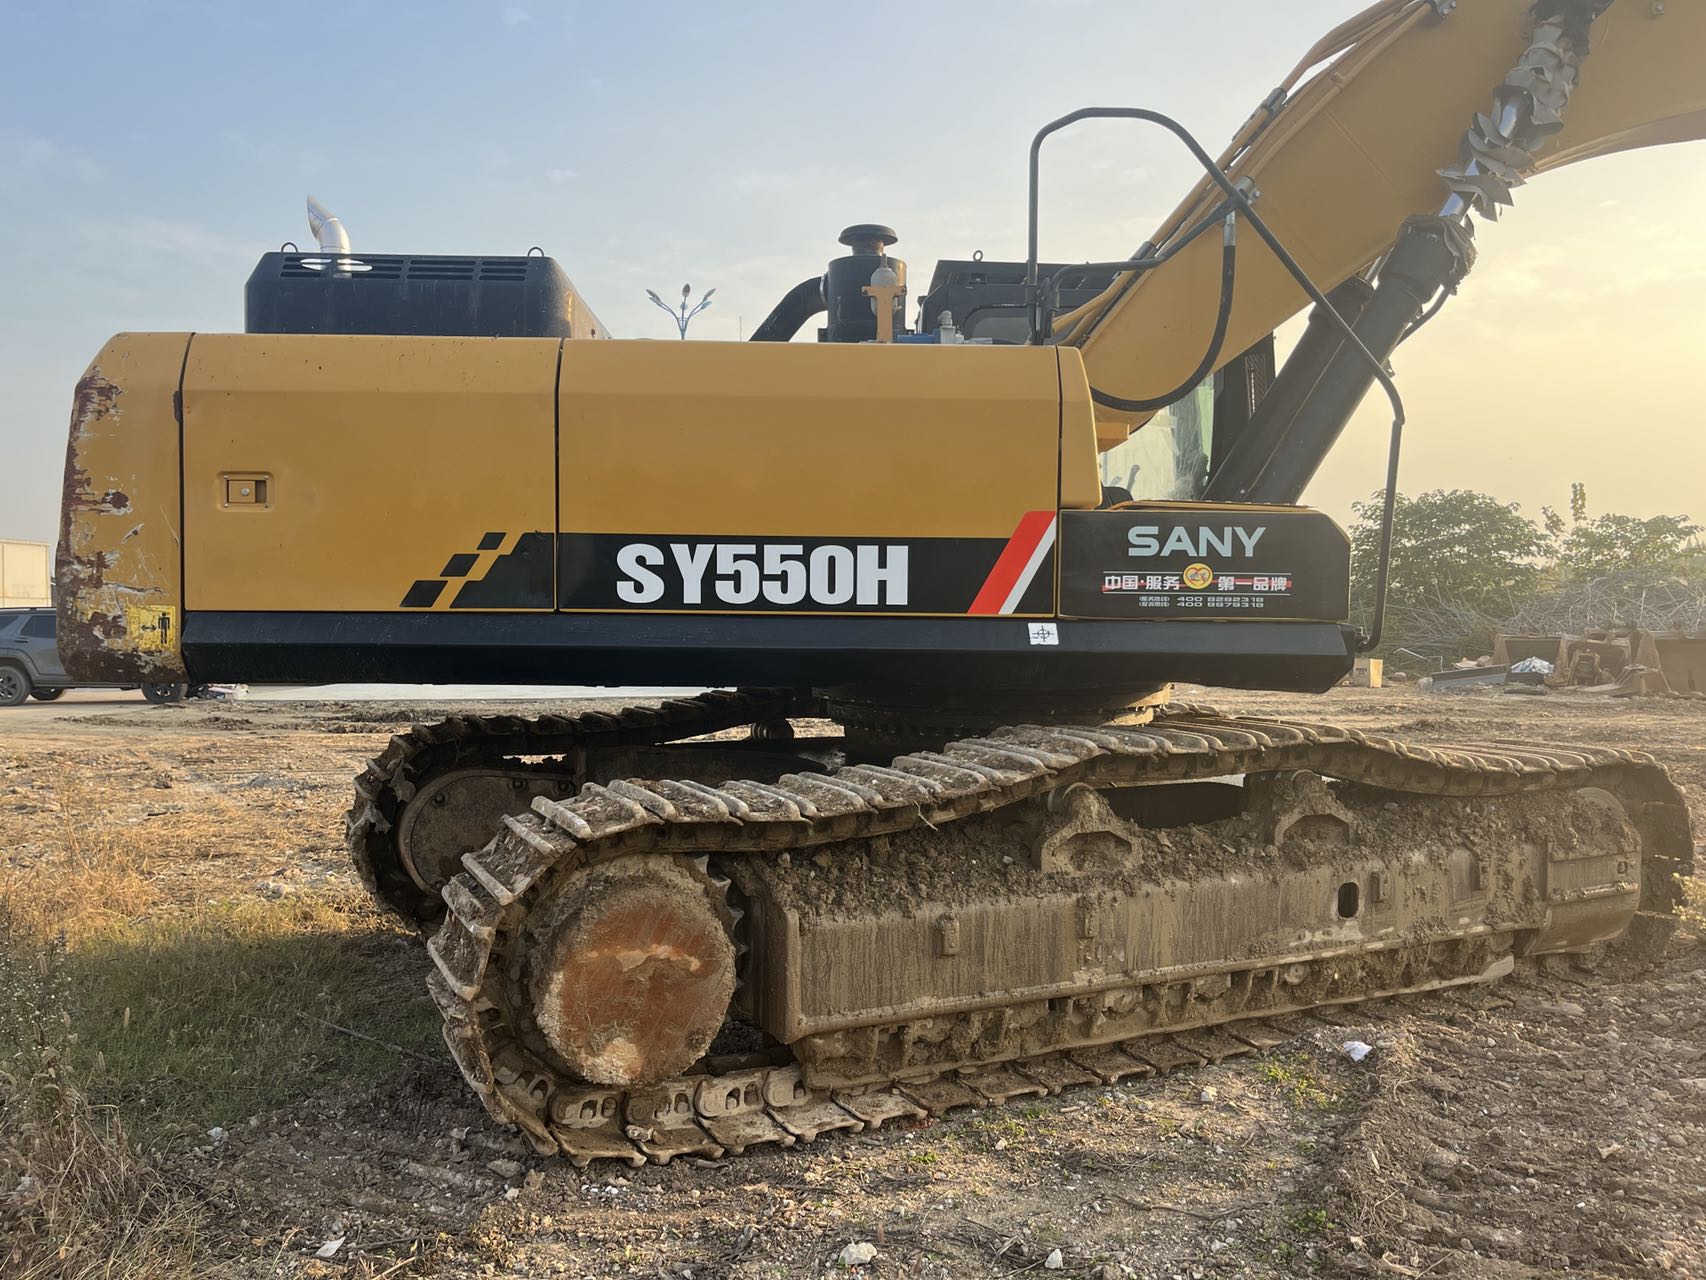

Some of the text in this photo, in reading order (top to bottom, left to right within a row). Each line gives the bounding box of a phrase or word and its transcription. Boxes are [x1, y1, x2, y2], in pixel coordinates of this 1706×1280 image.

[1127, 526, 1266, 557] SANY
[616, 543, 909, 606] SY550H
[1217, 576, 1287, 592] 第一品牌
